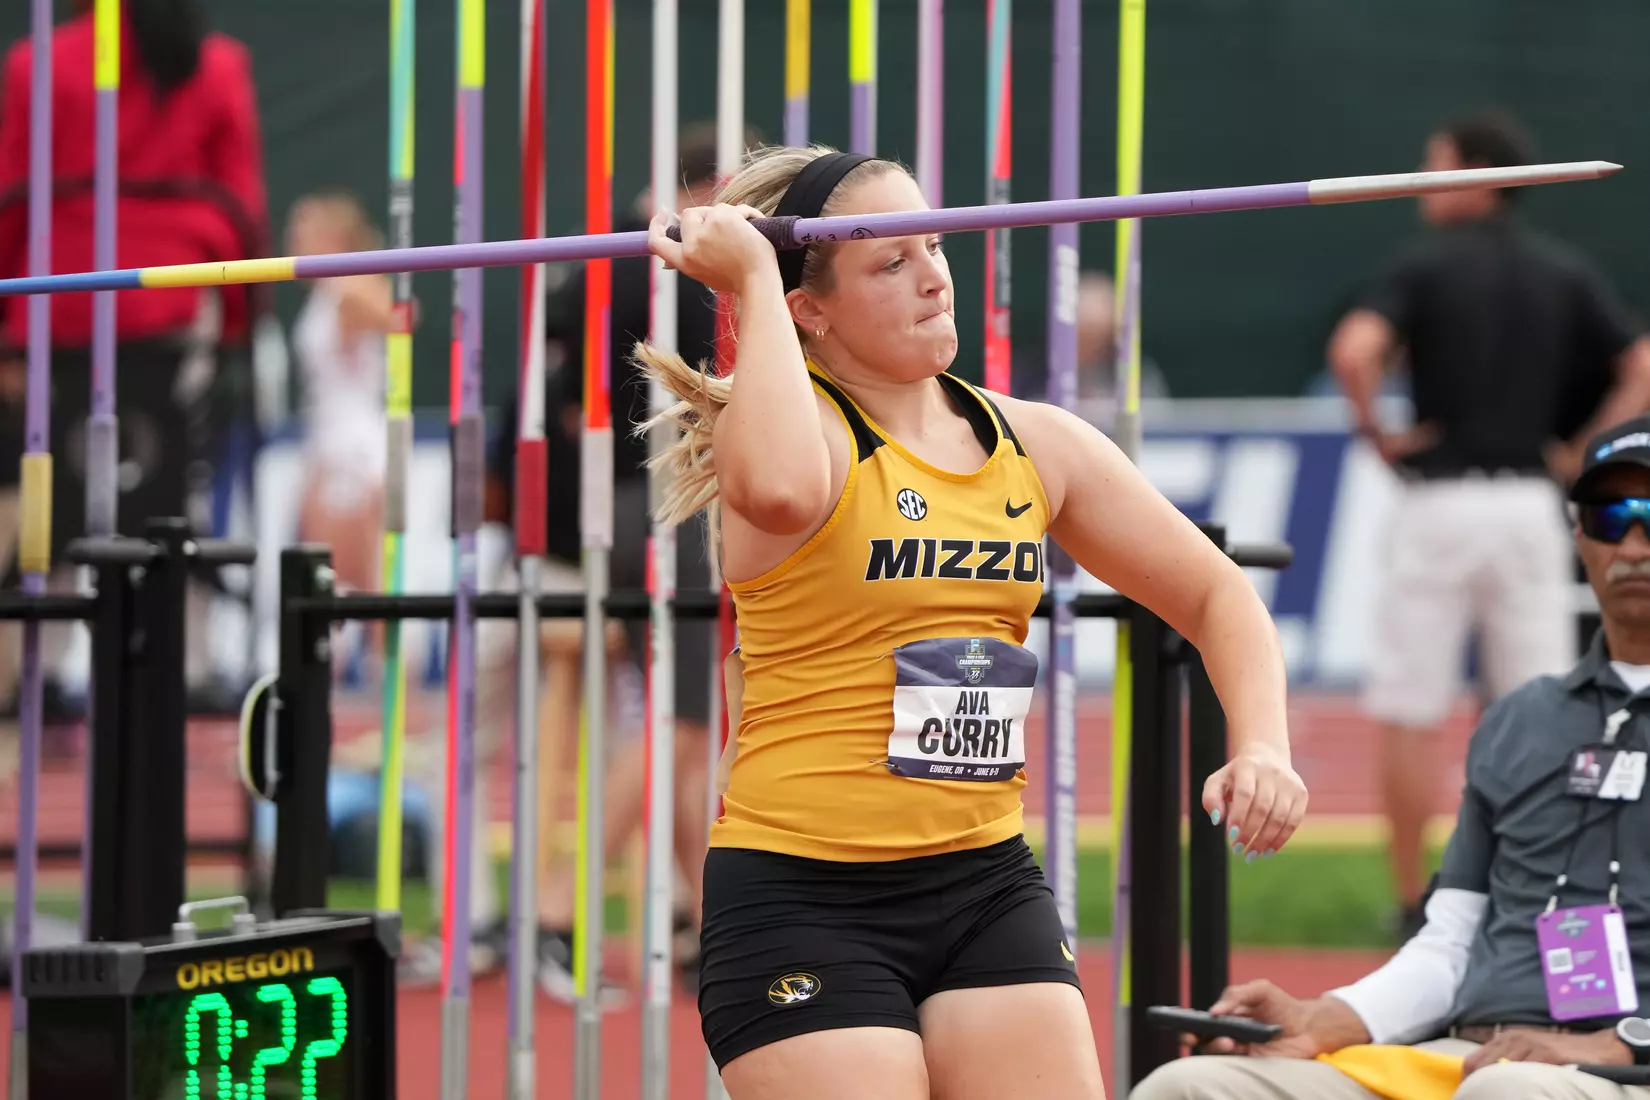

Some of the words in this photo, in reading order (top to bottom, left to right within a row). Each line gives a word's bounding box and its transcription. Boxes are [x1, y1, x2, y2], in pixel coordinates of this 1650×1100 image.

[897, 489, 926, 520] SEC
[864, 538, 1045, 583] MIZZO
[955, 691, 989, 715] AVA
[917, 717, 1013, 758] CURRY
[929, 764, 953, 774] EUGENE,
[954, 766, 964, 774] OR
[974, 767, 990, 776] JUNE
[176, 947, 314, 989] OREGON
[185, 976, 347, 1100] 0:22
